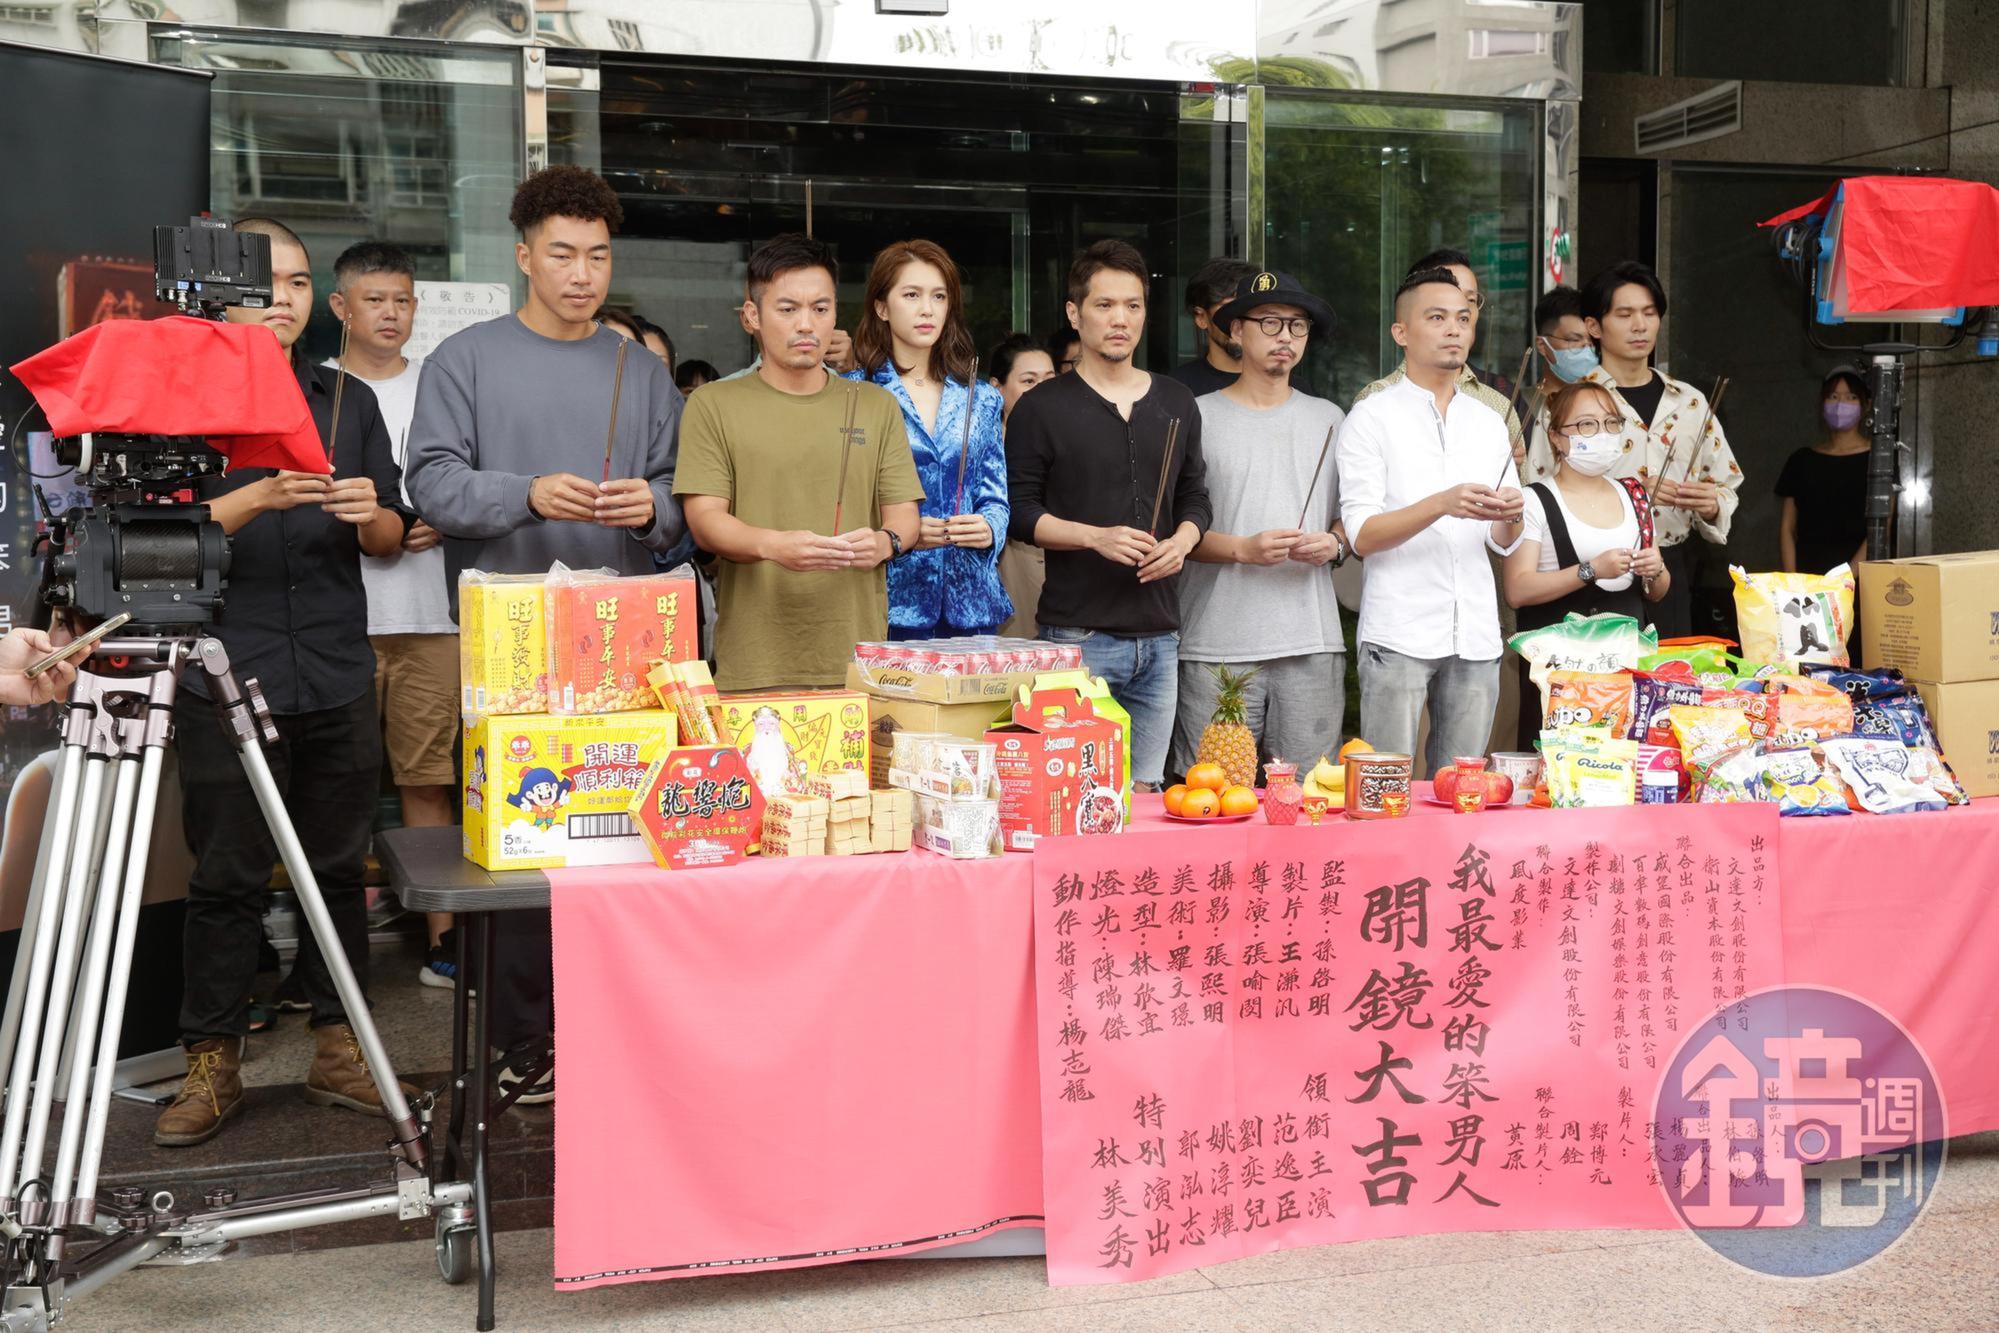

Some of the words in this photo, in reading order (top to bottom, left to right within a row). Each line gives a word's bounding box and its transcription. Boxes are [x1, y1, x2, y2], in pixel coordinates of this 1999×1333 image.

[595, 596, 619, 690] 旺事平安
[573, 767, 646, 793] 順利箱
[584, 742, 638, 768] 開運
[1577, 758, 1623, 771] Ricola
[1343, 876, 1434, 1207] 開鏡大吉
[1432, 842, 1504, 1208] 我最愛的笨男人
[1090, 1136, 1139, 1269] 林美秀
[1133, 1092, 1174, 1257] 特別演出
[1177, 1129, 1206, 1246] 郭泓志
[1206, 1120, 1239, 1238] 姚淳耀
[1238, 1115, 1271, 1233] 劉奕兒
[1272, 1112, 1303, 1223] 范逸臣
[1589, 1121, 1612, 1184] 鄭博元
